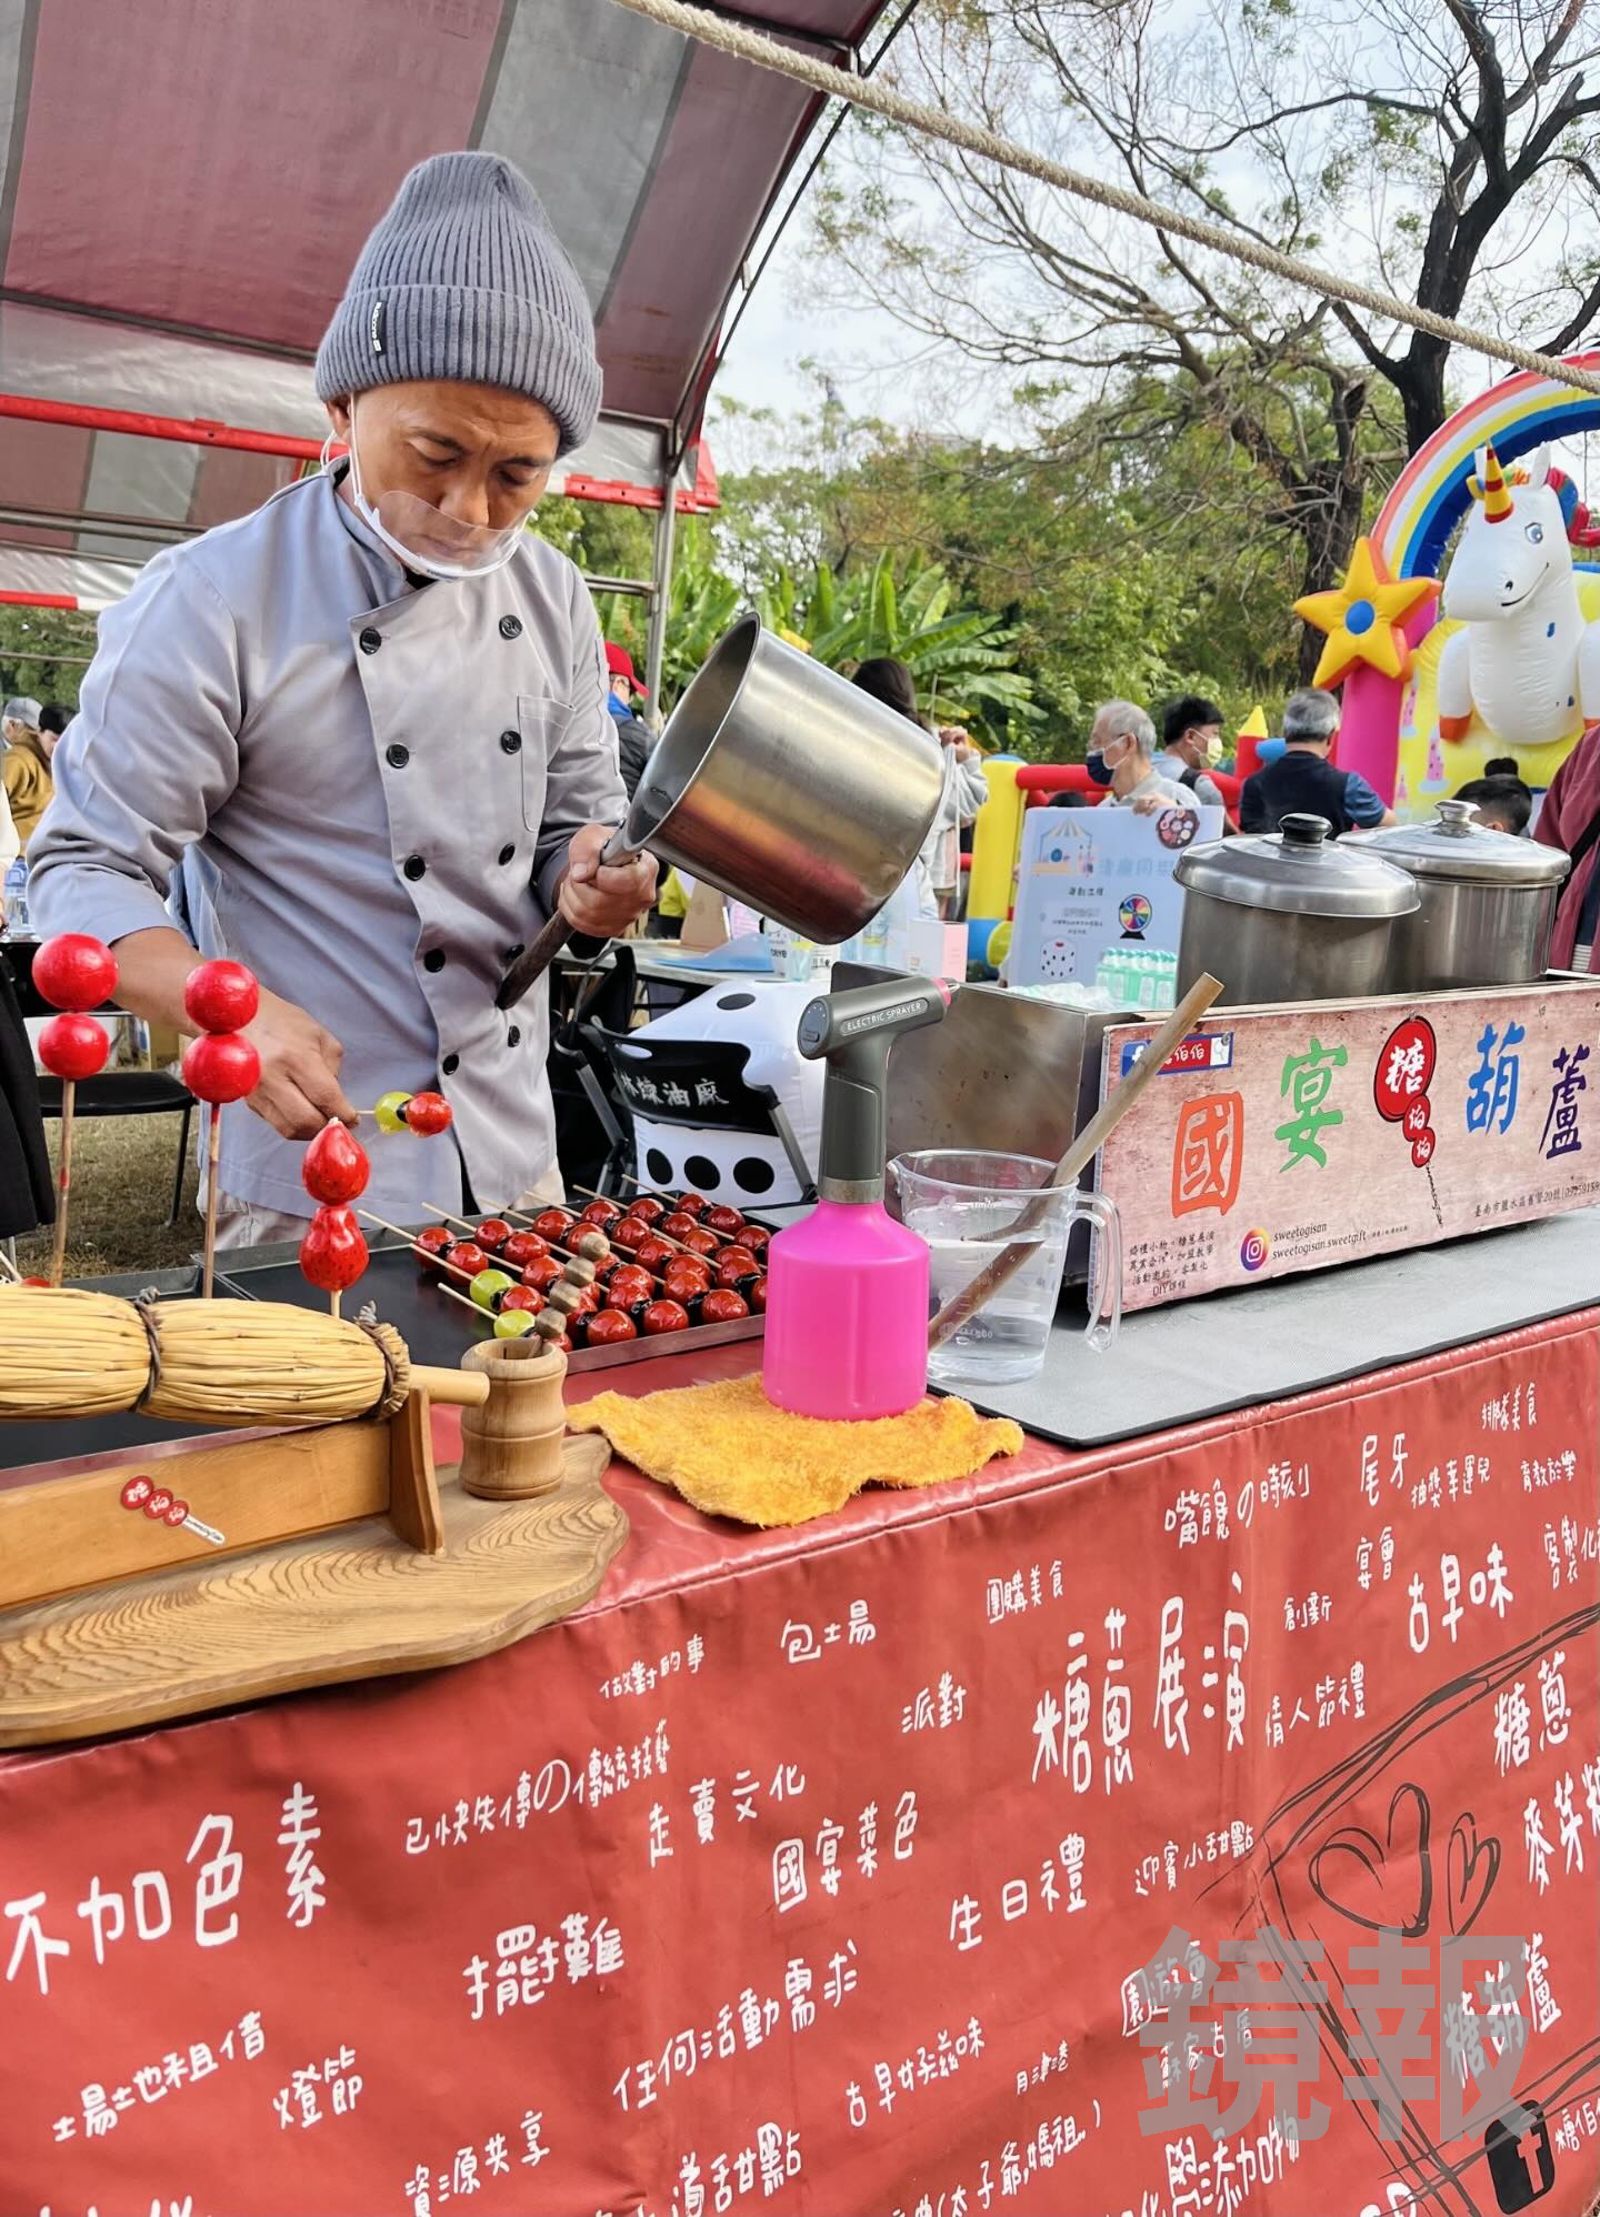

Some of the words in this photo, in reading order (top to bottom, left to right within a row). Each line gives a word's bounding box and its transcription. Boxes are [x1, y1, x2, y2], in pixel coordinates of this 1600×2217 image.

[846, 1012, 885, 1031] ELECTRIC
[886, 1002, 922, 1021] SPRAYER
[1171, 1037, 1348, 1219] 國宴
[1465, 1020, 1592, 1160] 葫蘆
[1481, 1382, 1537, 1431] 排隊美食
[1360, 1432, 1409, 1507] 尾牙
[986, 1560, 1063, 1624] 團購美食
[1356, 1526, 1394, 1590] 宴會
[1543, 1515, 1600, 1589] 客製化
[780, 1599, 876, 1664] 包場
[1283, 1591, 1332, 1631] 創新
[1407, 1542, 1514, 1654] 古早味
[599, 1634, 705, 1698] 做對的事
[901, 1671, 967, 1734] 派對
[1031, 1572, 1250, 1795] 糖蔥展演
[1265, 1661, 1366, 1748] 情人節禮
[1493, 1650, 1573, 1783] 糖蔥
[648, 1763, 805, 1868] 走賣文化
[769, 1784, 918, 1913] 國宴菜色
[4, 1782, 326, 1995] 不加色素
[949, 1832, 1087, 1951] 生日禮
[1135, 1820, 1254, 1896] 迎賓小甜點
[612, 1941, 859, 2111] 任何活動需求
[1016, 2040, 1068, 2095] 月津港
[52, 2011, 265, 2142] 場地租借
[272, 2045, 363, 2129] 燈節
[845, 2016, 985, 2127] 古早好滋味
[405, 2110, 550, 2217] 資源共享
[1555, 2097, 1600, 2154] 糖伯
